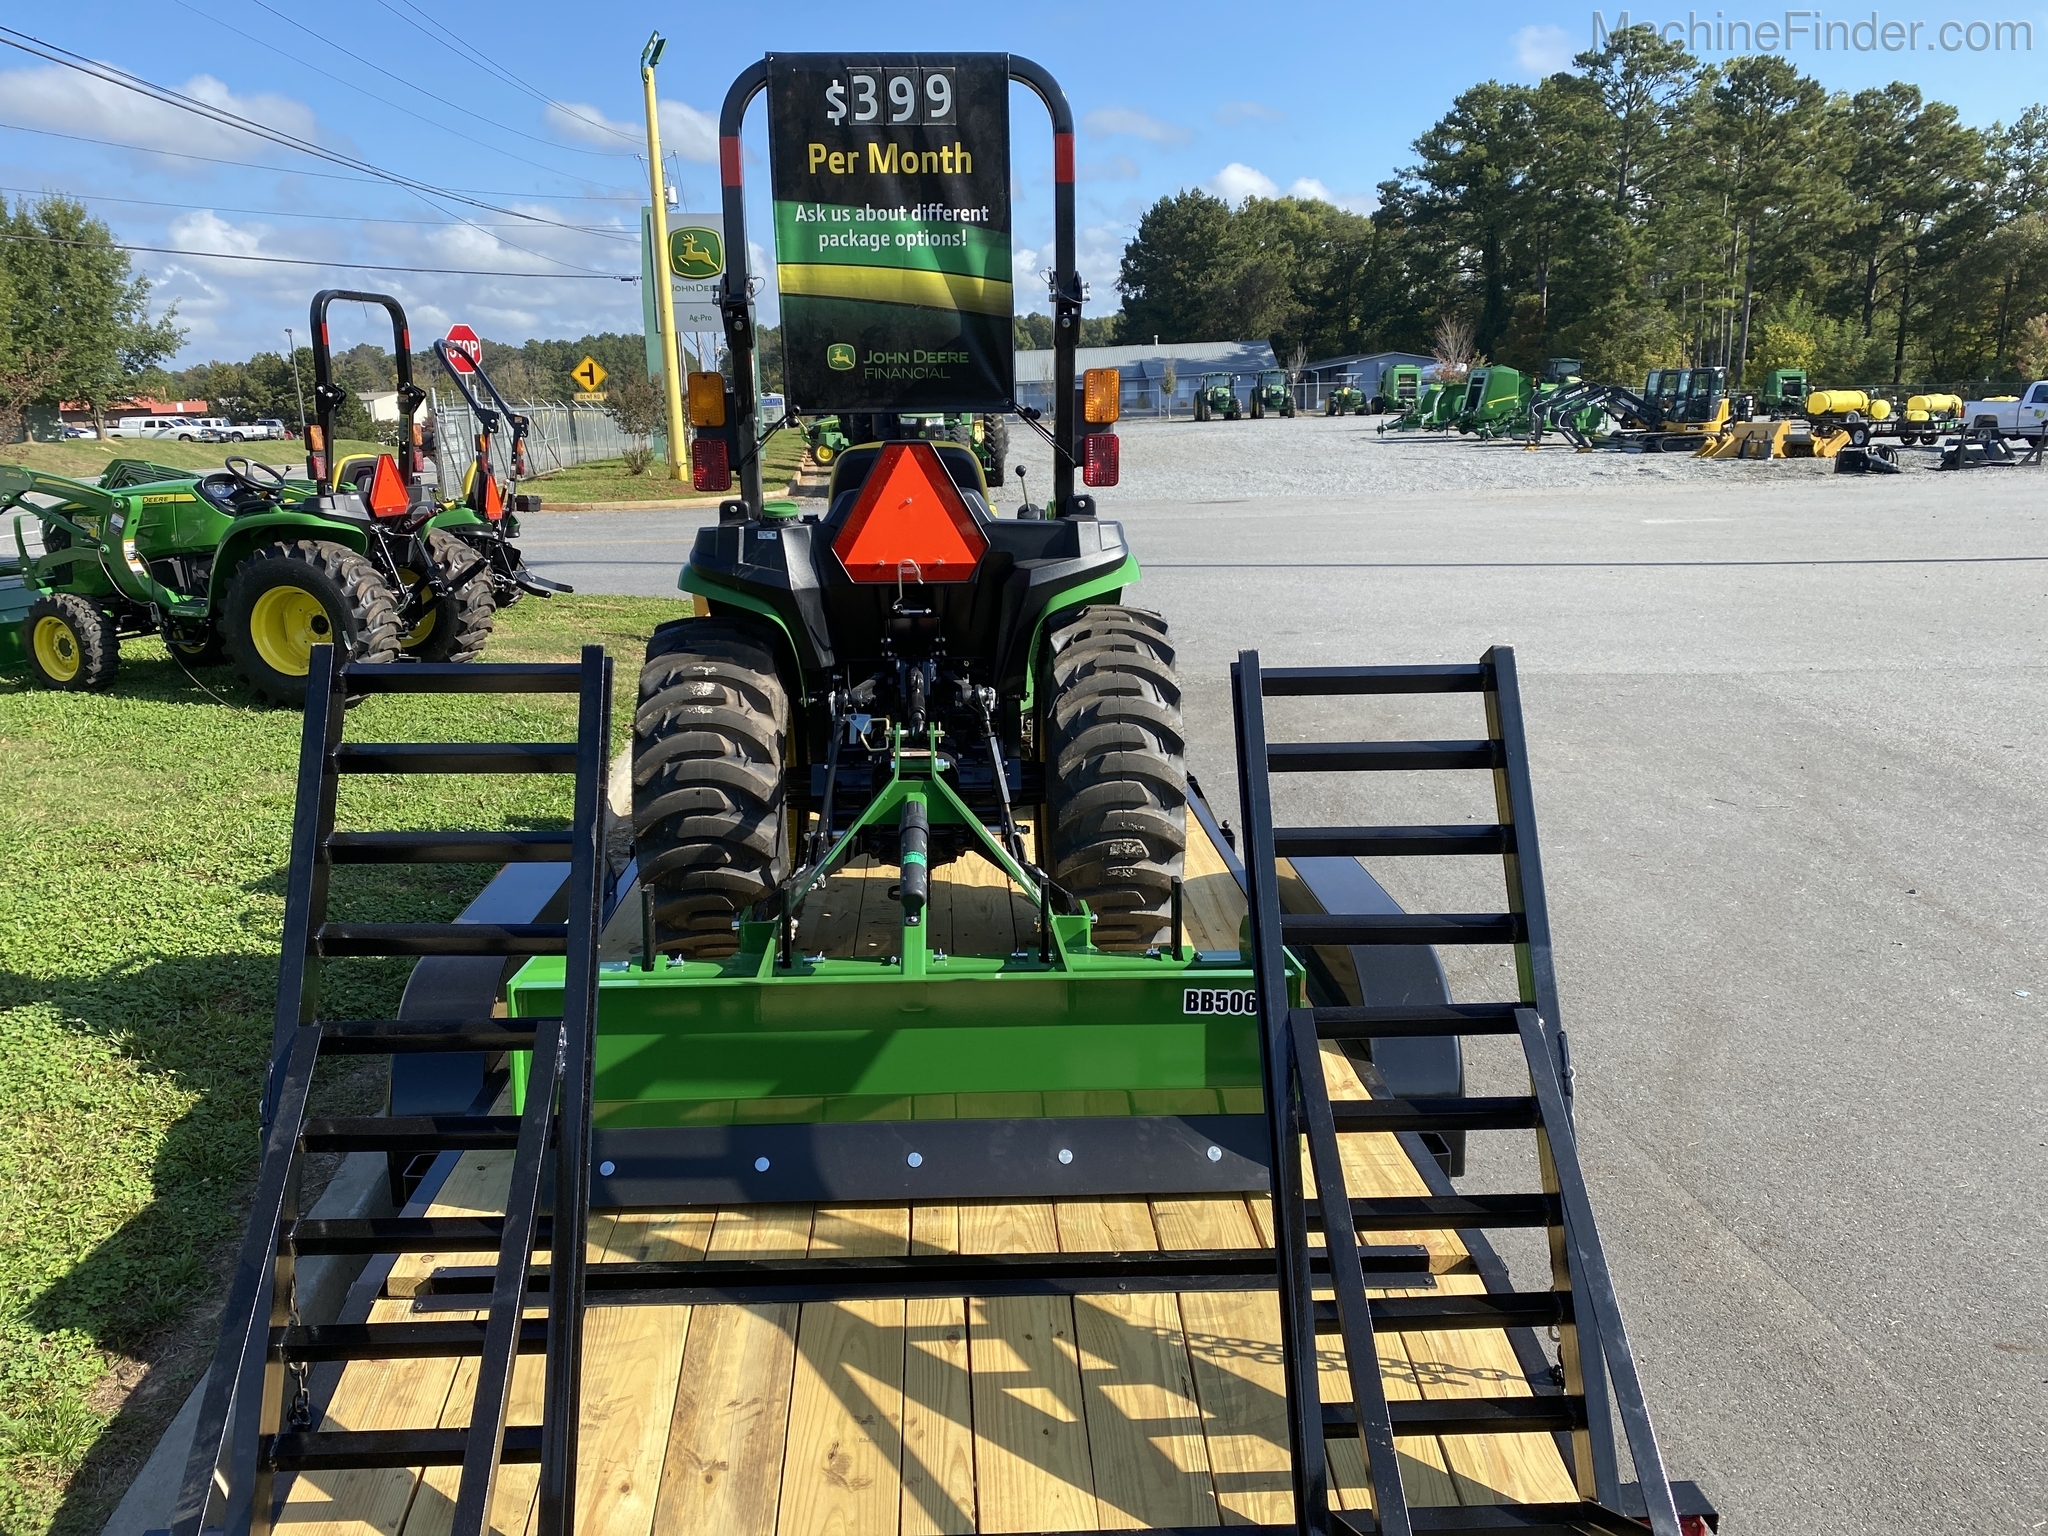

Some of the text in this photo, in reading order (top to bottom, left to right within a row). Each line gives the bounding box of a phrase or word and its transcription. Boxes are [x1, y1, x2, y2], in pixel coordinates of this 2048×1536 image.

[826, 74, 952, 126] $399
[808, 141, 972, 174] Per Month
[795, 203, 990, 222] Ask us about different
[818, 229, 967, 252] package options!
[672, 284, 695, 292] JOHN
[689, 314, 712, 322] Ag-Pro
[863, 349, 969, 364] JOHN DEERE
[864, 367, 951, 380] FINANCIAL
